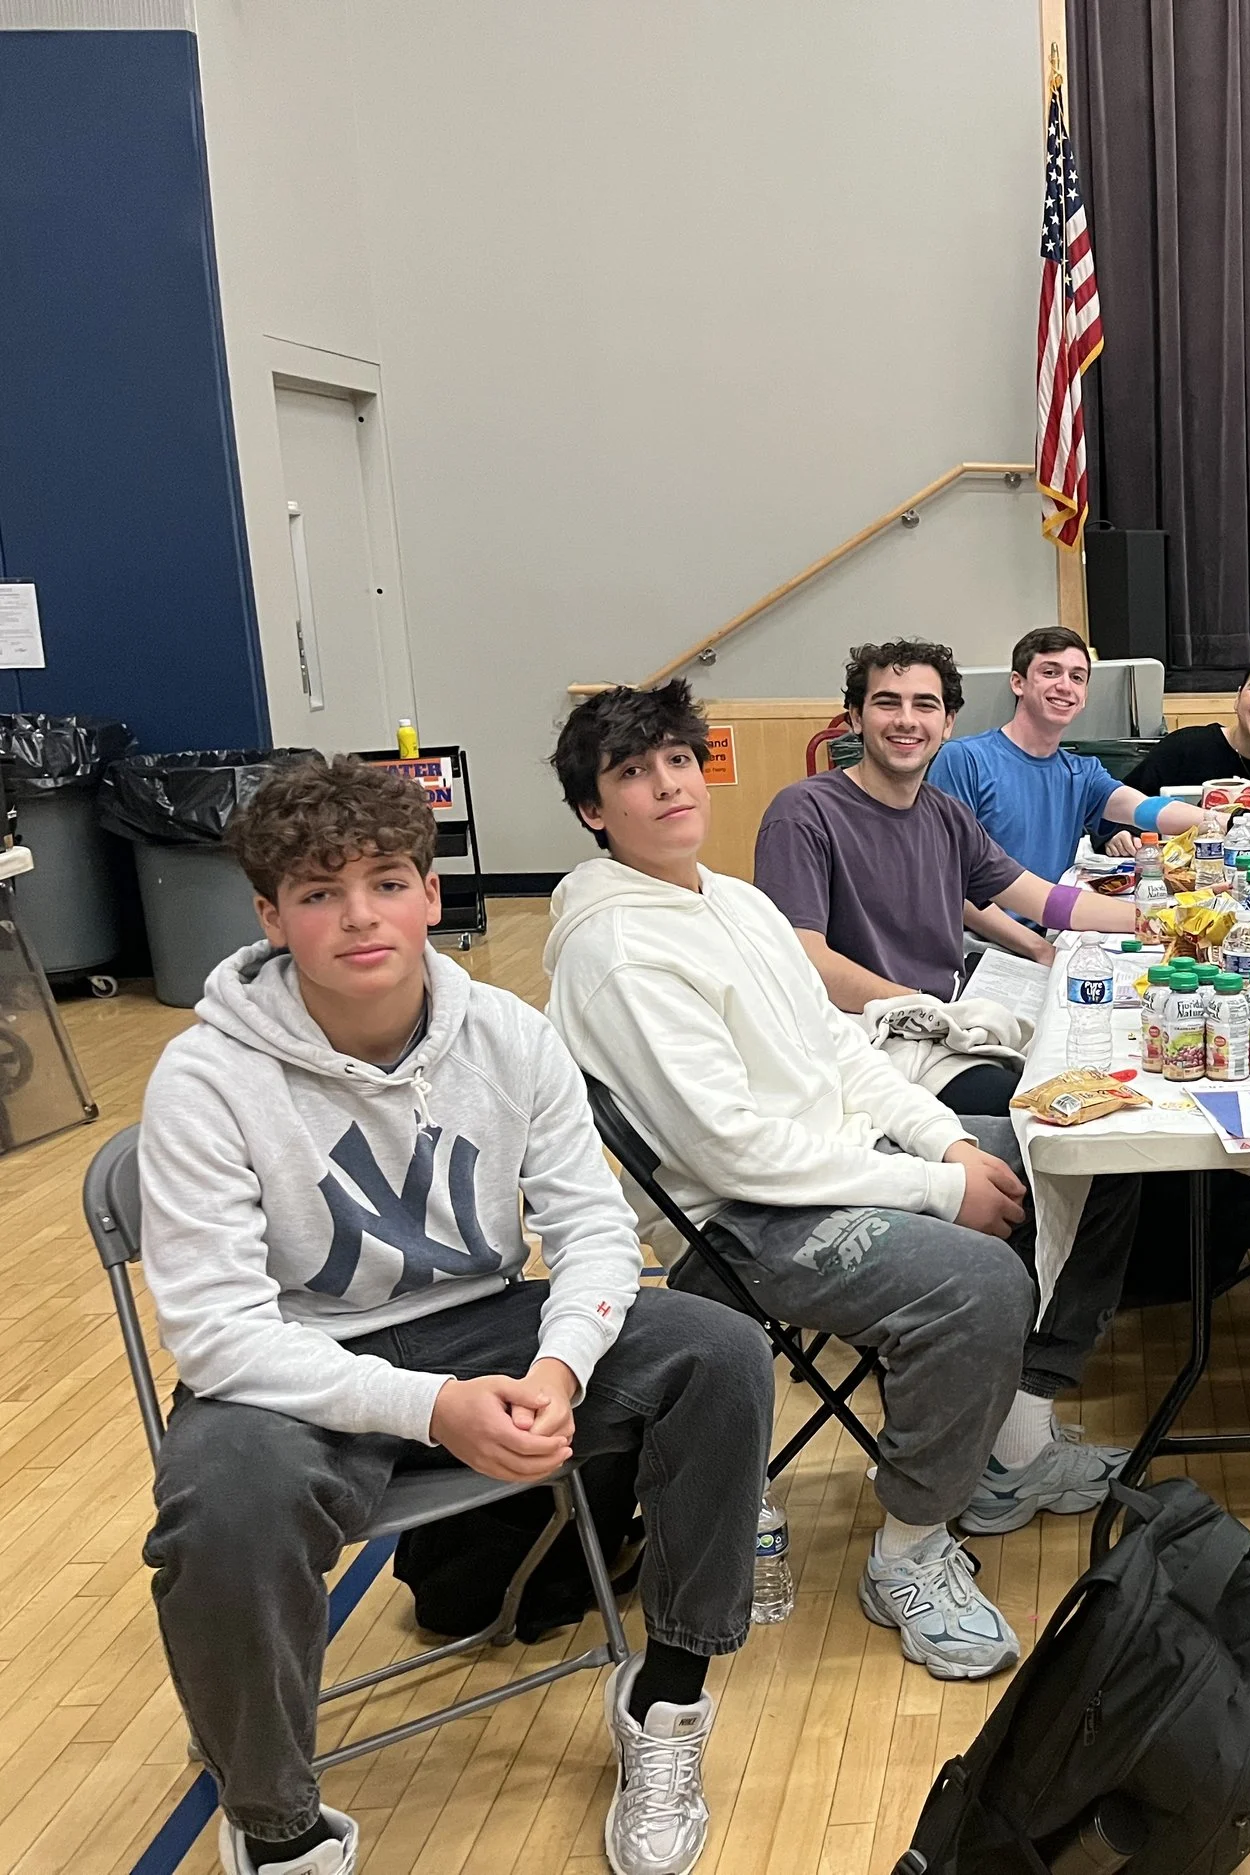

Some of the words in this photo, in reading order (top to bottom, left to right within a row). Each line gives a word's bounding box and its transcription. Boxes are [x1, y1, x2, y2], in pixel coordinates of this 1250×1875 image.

[709, 753, 726, 762] ers
[386, 762, 443, 779] ATER
[1084, 981, 1103, 990] Pure
[1086, 987, 1101, 999] Life
[303, 1107, 503, 1301] NY
[678, 1716, 698, 1727] NIKE
